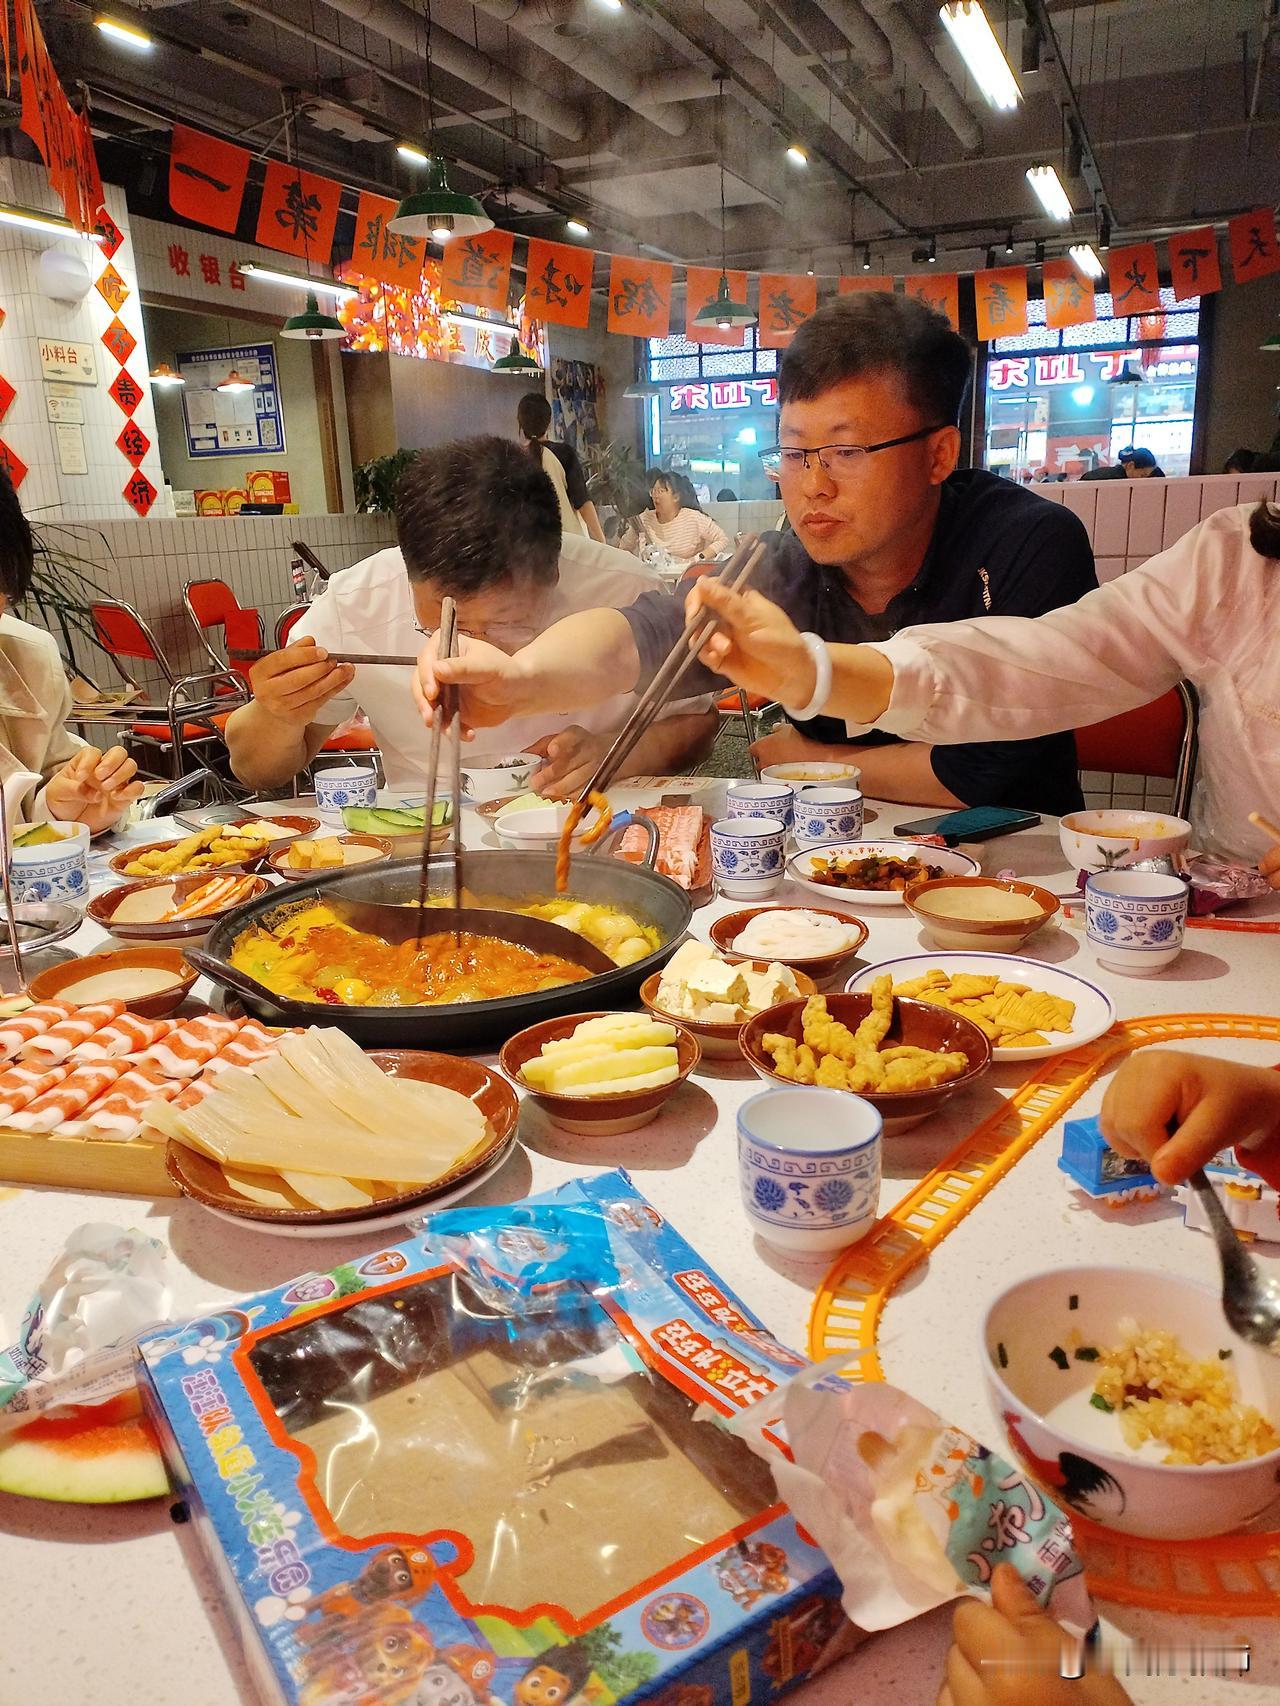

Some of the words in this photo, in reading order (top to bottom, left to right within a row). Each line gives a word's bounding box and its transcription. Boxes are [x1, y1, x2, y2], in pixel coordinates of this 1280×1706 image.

[167, 242, 247, 292] 收银台
[41, 344, 79, 365] 小料台
